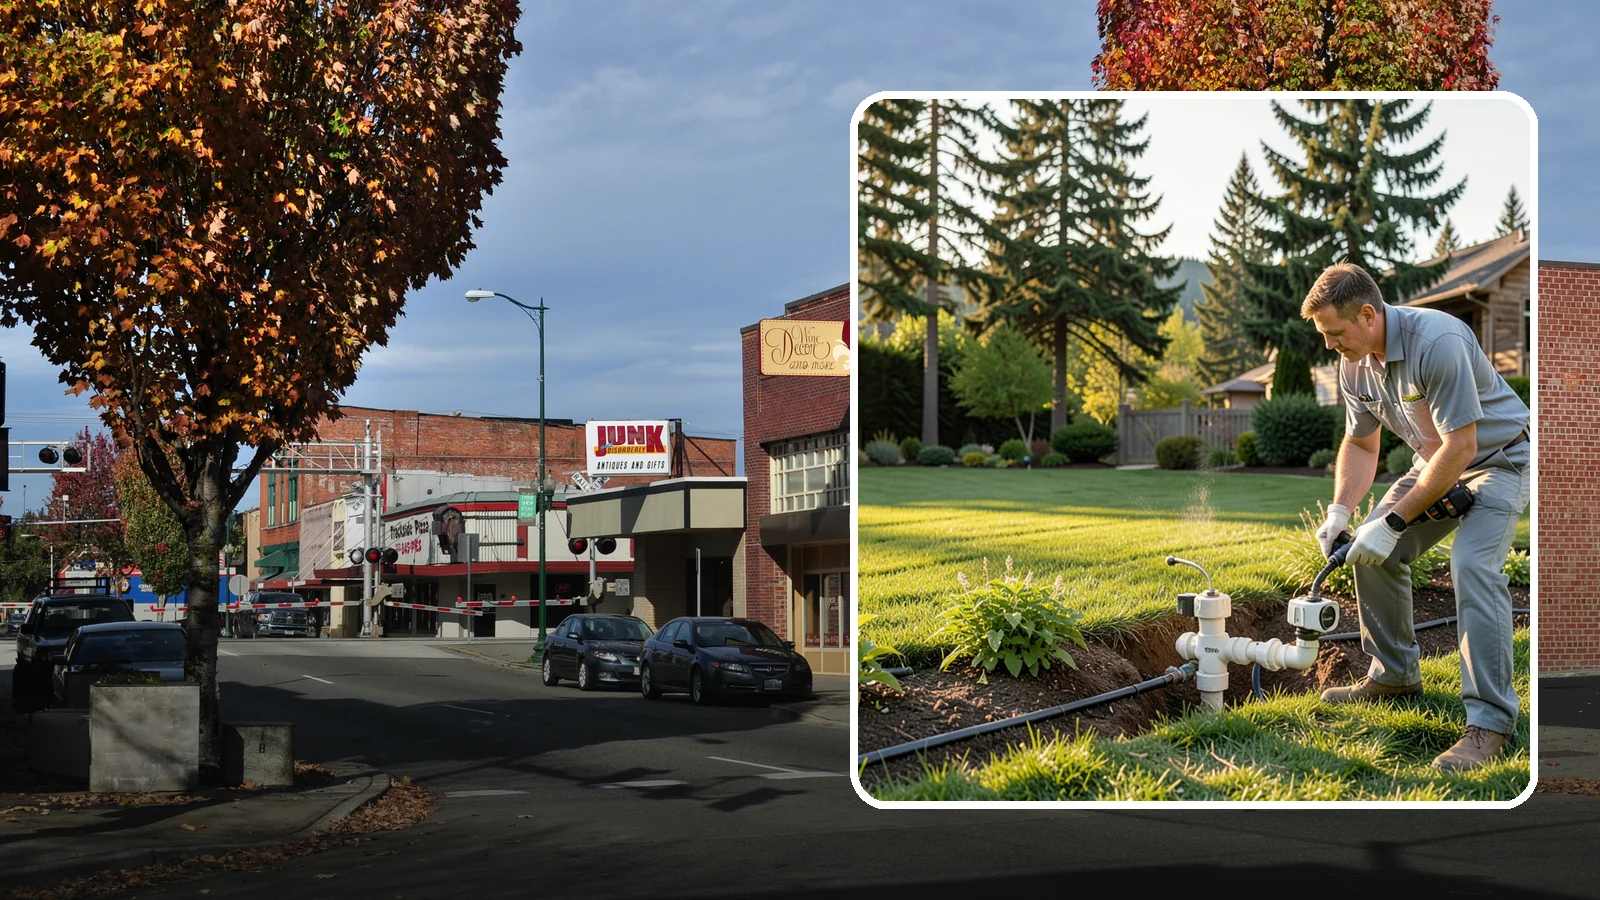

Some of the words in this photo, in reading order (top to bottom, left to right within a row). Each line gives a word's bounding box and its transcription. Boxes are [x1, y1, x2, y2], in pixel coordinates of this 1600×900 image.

[595, 425, 666, 457] JUNK
[607, 446, 645, 454] DISORDERLY
[597, 461, 628, 470] ANTIQUES
[631, 461, 643, 470] AND
[647, 460, 665, 469] GIFTS
[414, 519, 429, 535] Pizza
